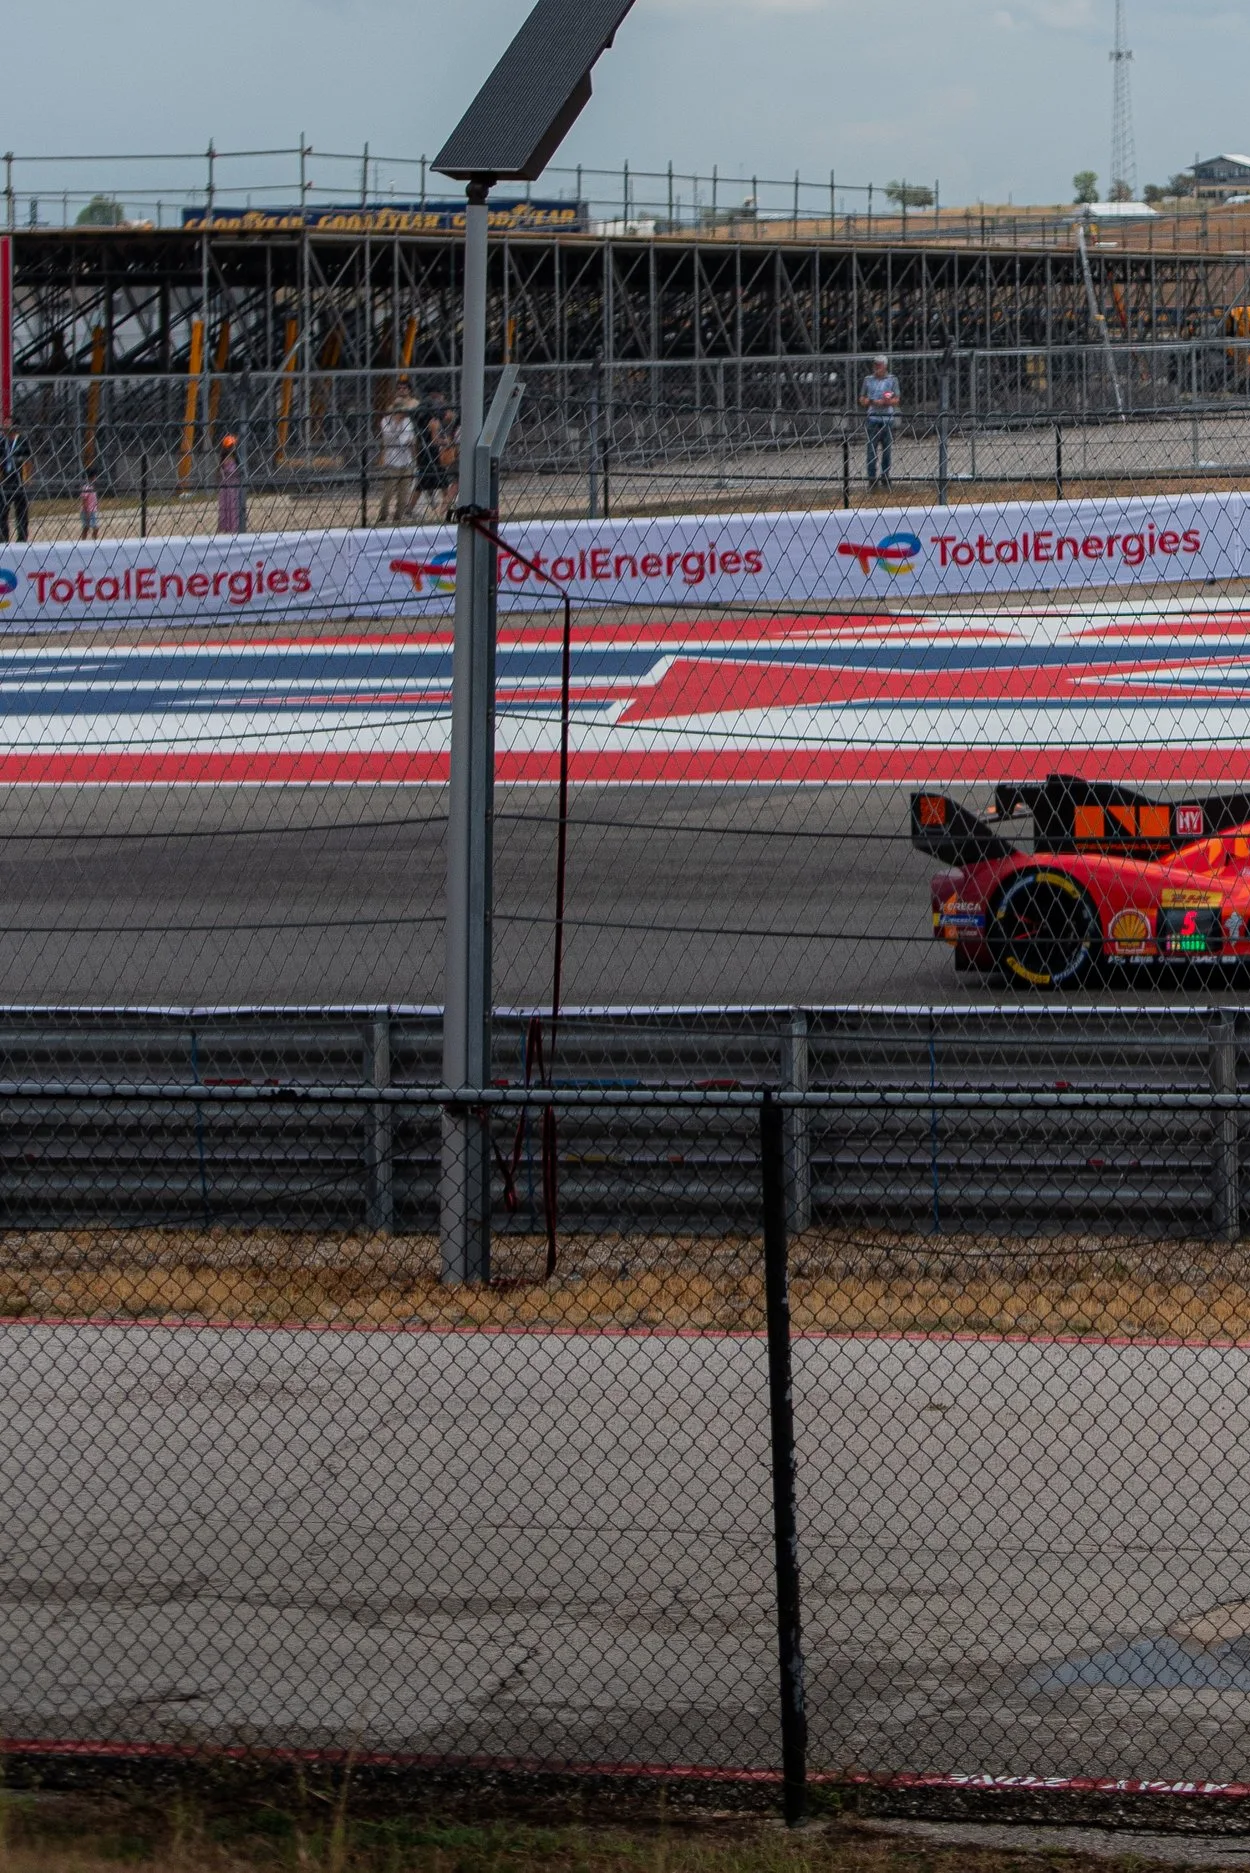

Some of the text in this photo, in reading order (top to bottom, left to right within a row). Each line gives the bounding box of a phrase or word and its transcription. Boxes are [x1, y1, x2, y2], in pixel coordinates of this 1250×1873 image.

[453, 204, 576, 228] GODYEAR
[931, 523, 1201, 567] TotalEnergies
[28, 560, 312, 605] TotalEnergies
